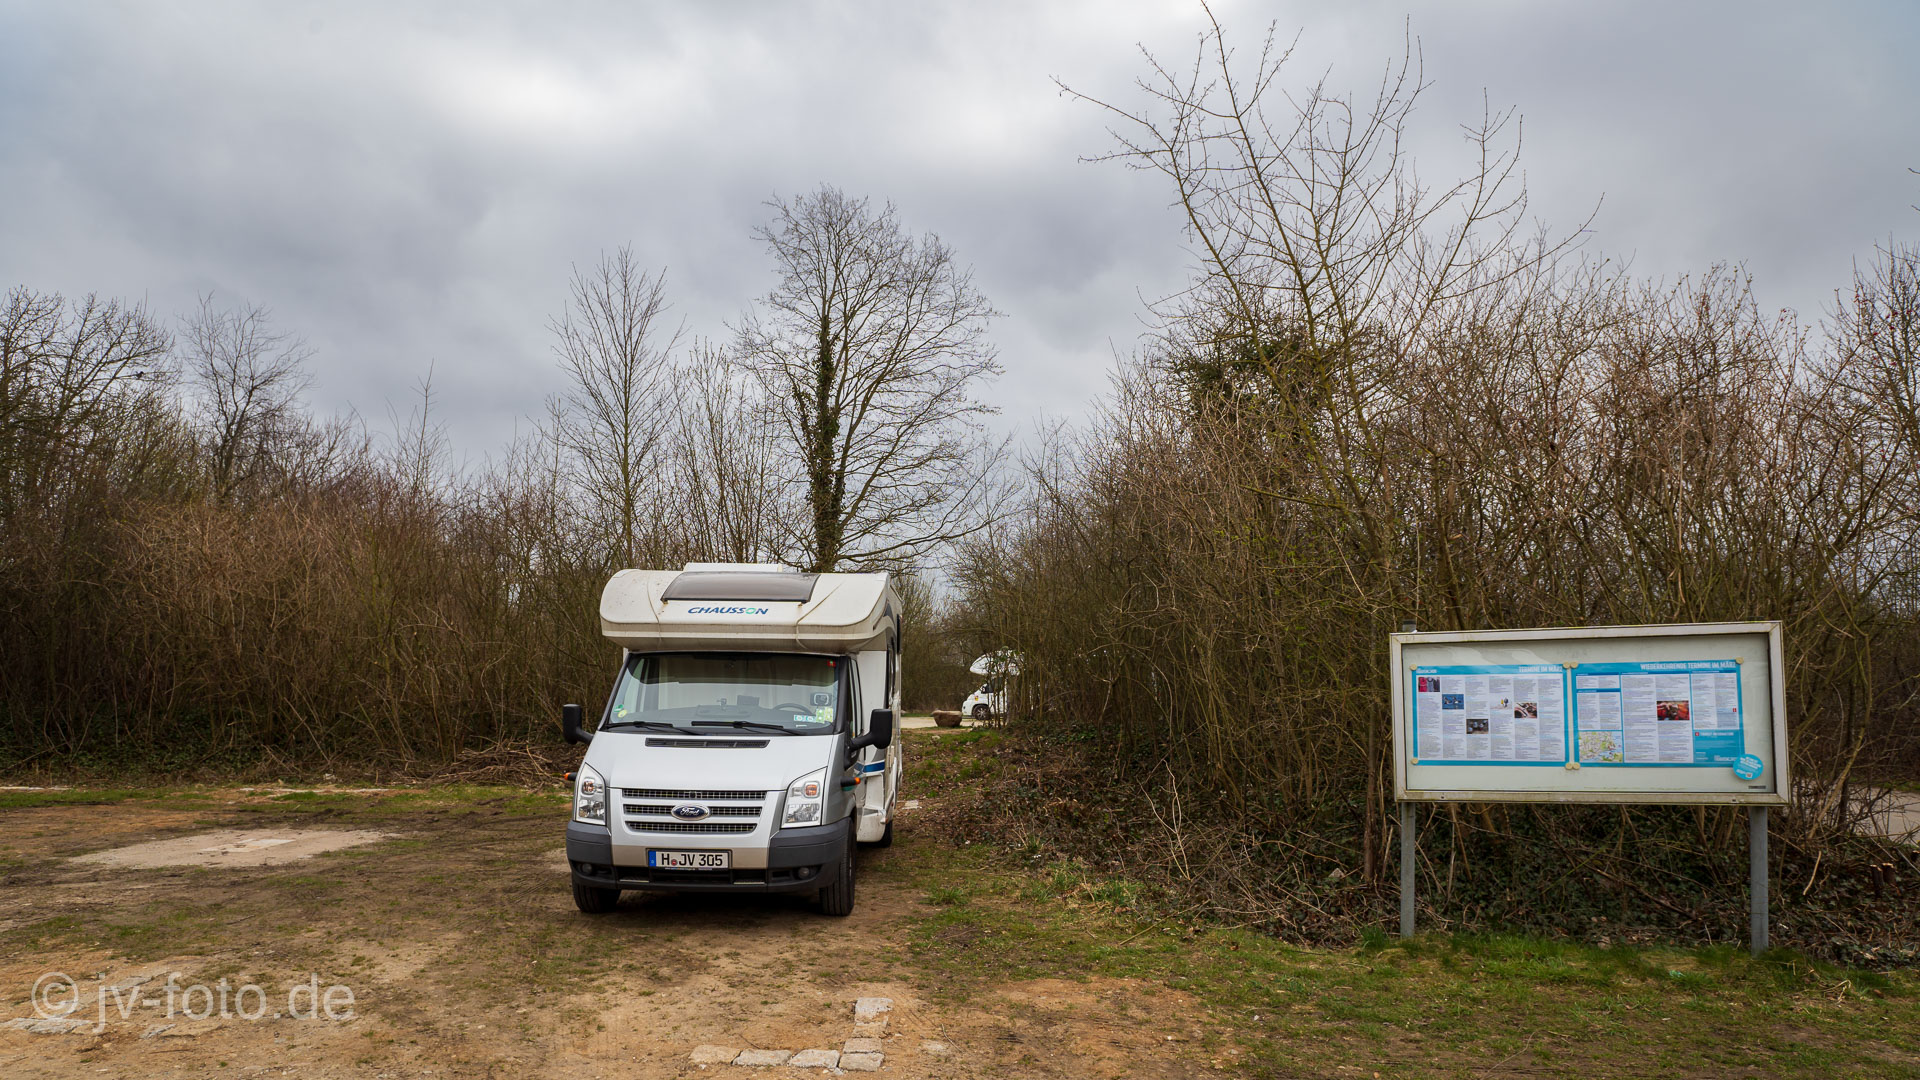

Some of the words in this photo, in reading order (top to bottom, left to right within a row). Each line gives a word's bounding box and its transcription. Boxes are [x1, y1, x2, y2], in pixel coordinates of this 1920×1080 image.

[688, 607, 769, 615] CHAUSSON
[1519, 665, 1540, 673] TERMINE
[680, 807, 700, 816] Ford
[661, 853, 670, 866] H
[679, 853, 696, 867] JV
[698, 854, 723, 867] 305
